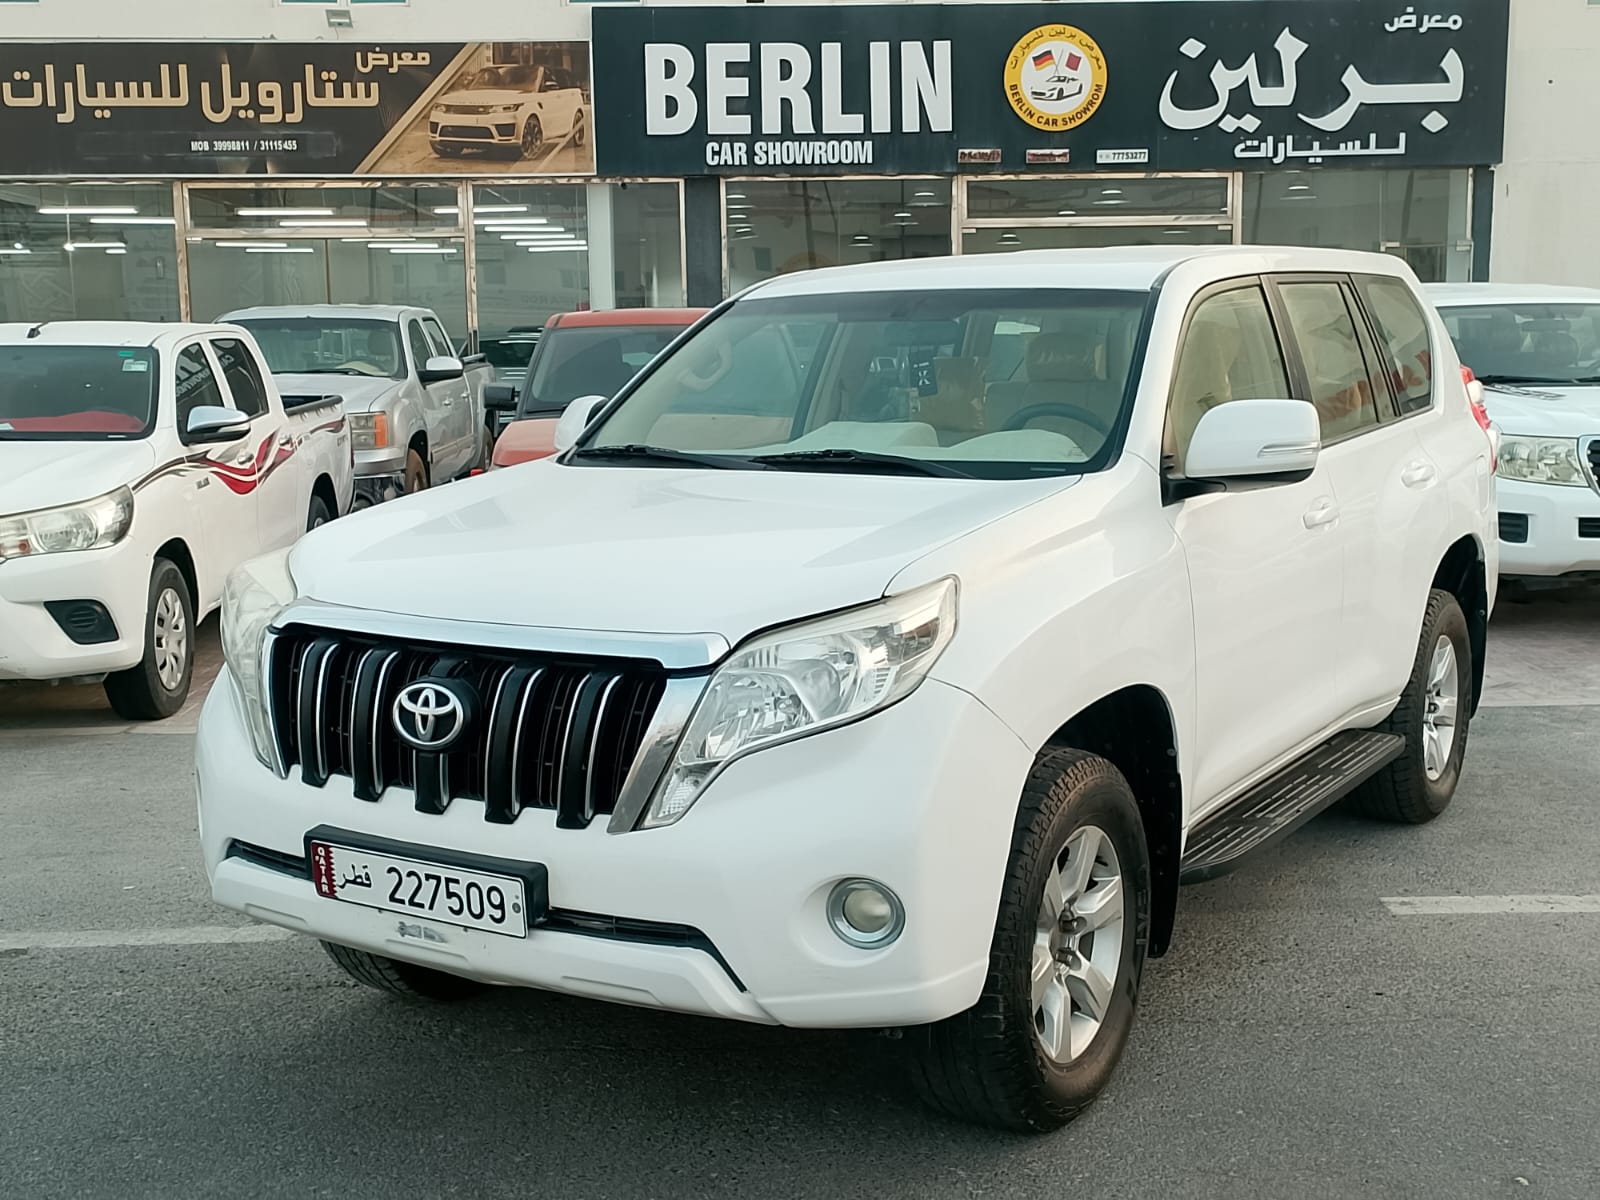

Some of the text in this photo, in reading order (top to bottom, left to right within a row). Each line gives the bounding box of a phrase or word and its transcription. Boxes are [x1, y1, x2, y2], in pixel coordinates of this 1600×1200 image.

[1048, 27, 1077, 39] برلين
[1384, 6, 1463, 33] معرض
[356, 47, 431, 74] معرض
[2, 63, 190, 124] للسيارات
[644, 39, 954, 136] BERLIN
[1158, 26, 1465, 133] برلين
[1009, 83, 1104, 127] BERLIN CAR SHOWROM
[190, 140, 210, 151] MOB
[706, 140, 873, 166] CAR SHOWROOM
[1233, 131, 1406, 164] للسيارات
[315, 846, 330, 894] QATAR
[337, 863, 373, 890] قطر
[386, 866, 507, 925] 227509
